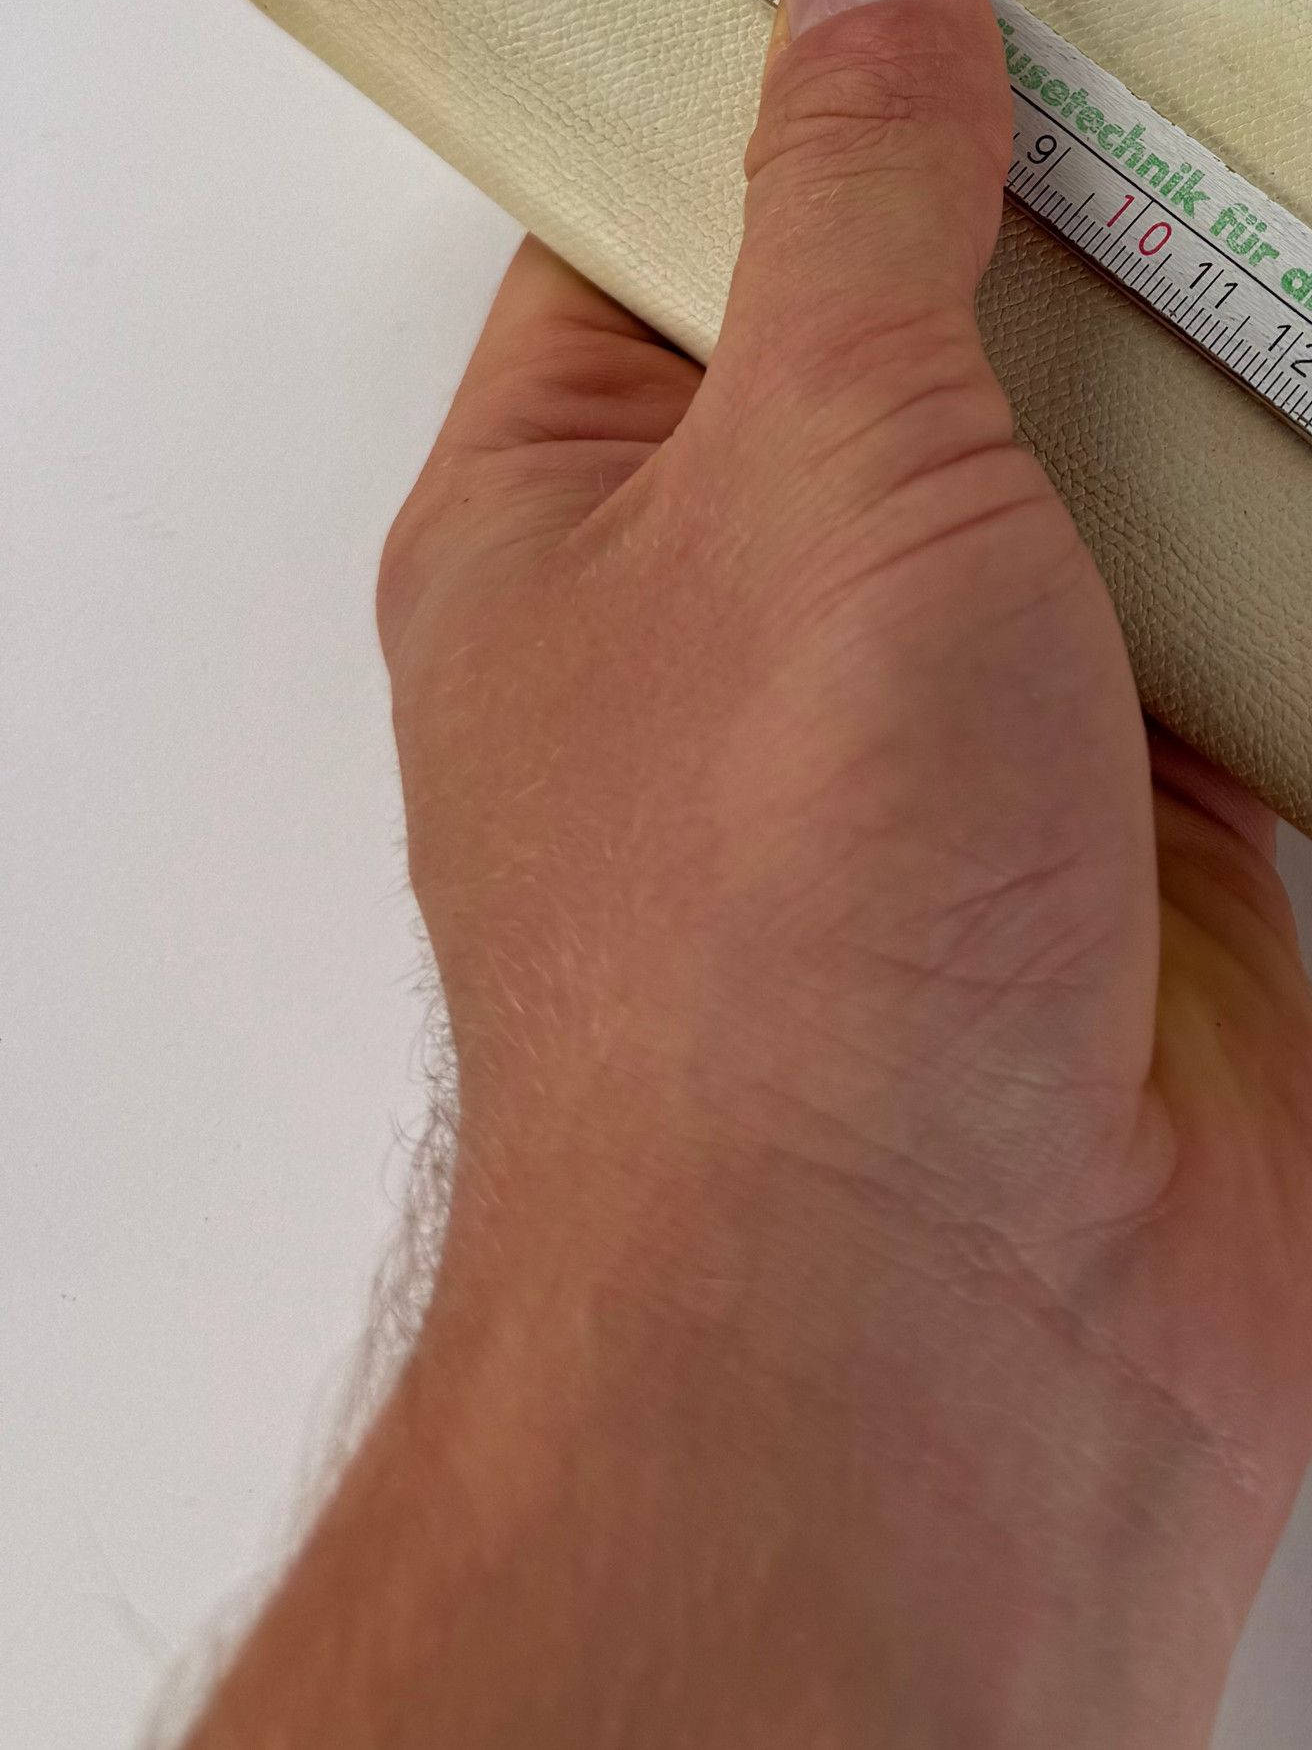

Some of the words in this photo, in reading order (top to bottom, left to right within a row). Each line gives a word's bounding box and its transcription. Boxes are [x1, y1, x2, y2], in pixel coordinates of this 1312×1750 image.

[998, 18, 1211, 219] usetechnik
[1209, 202, 1280, 267] für
[1027, 134, 1058, 164] 9
[1106, 194, 1173, 256] 10
[1189, 262, 1238, 308] 11
